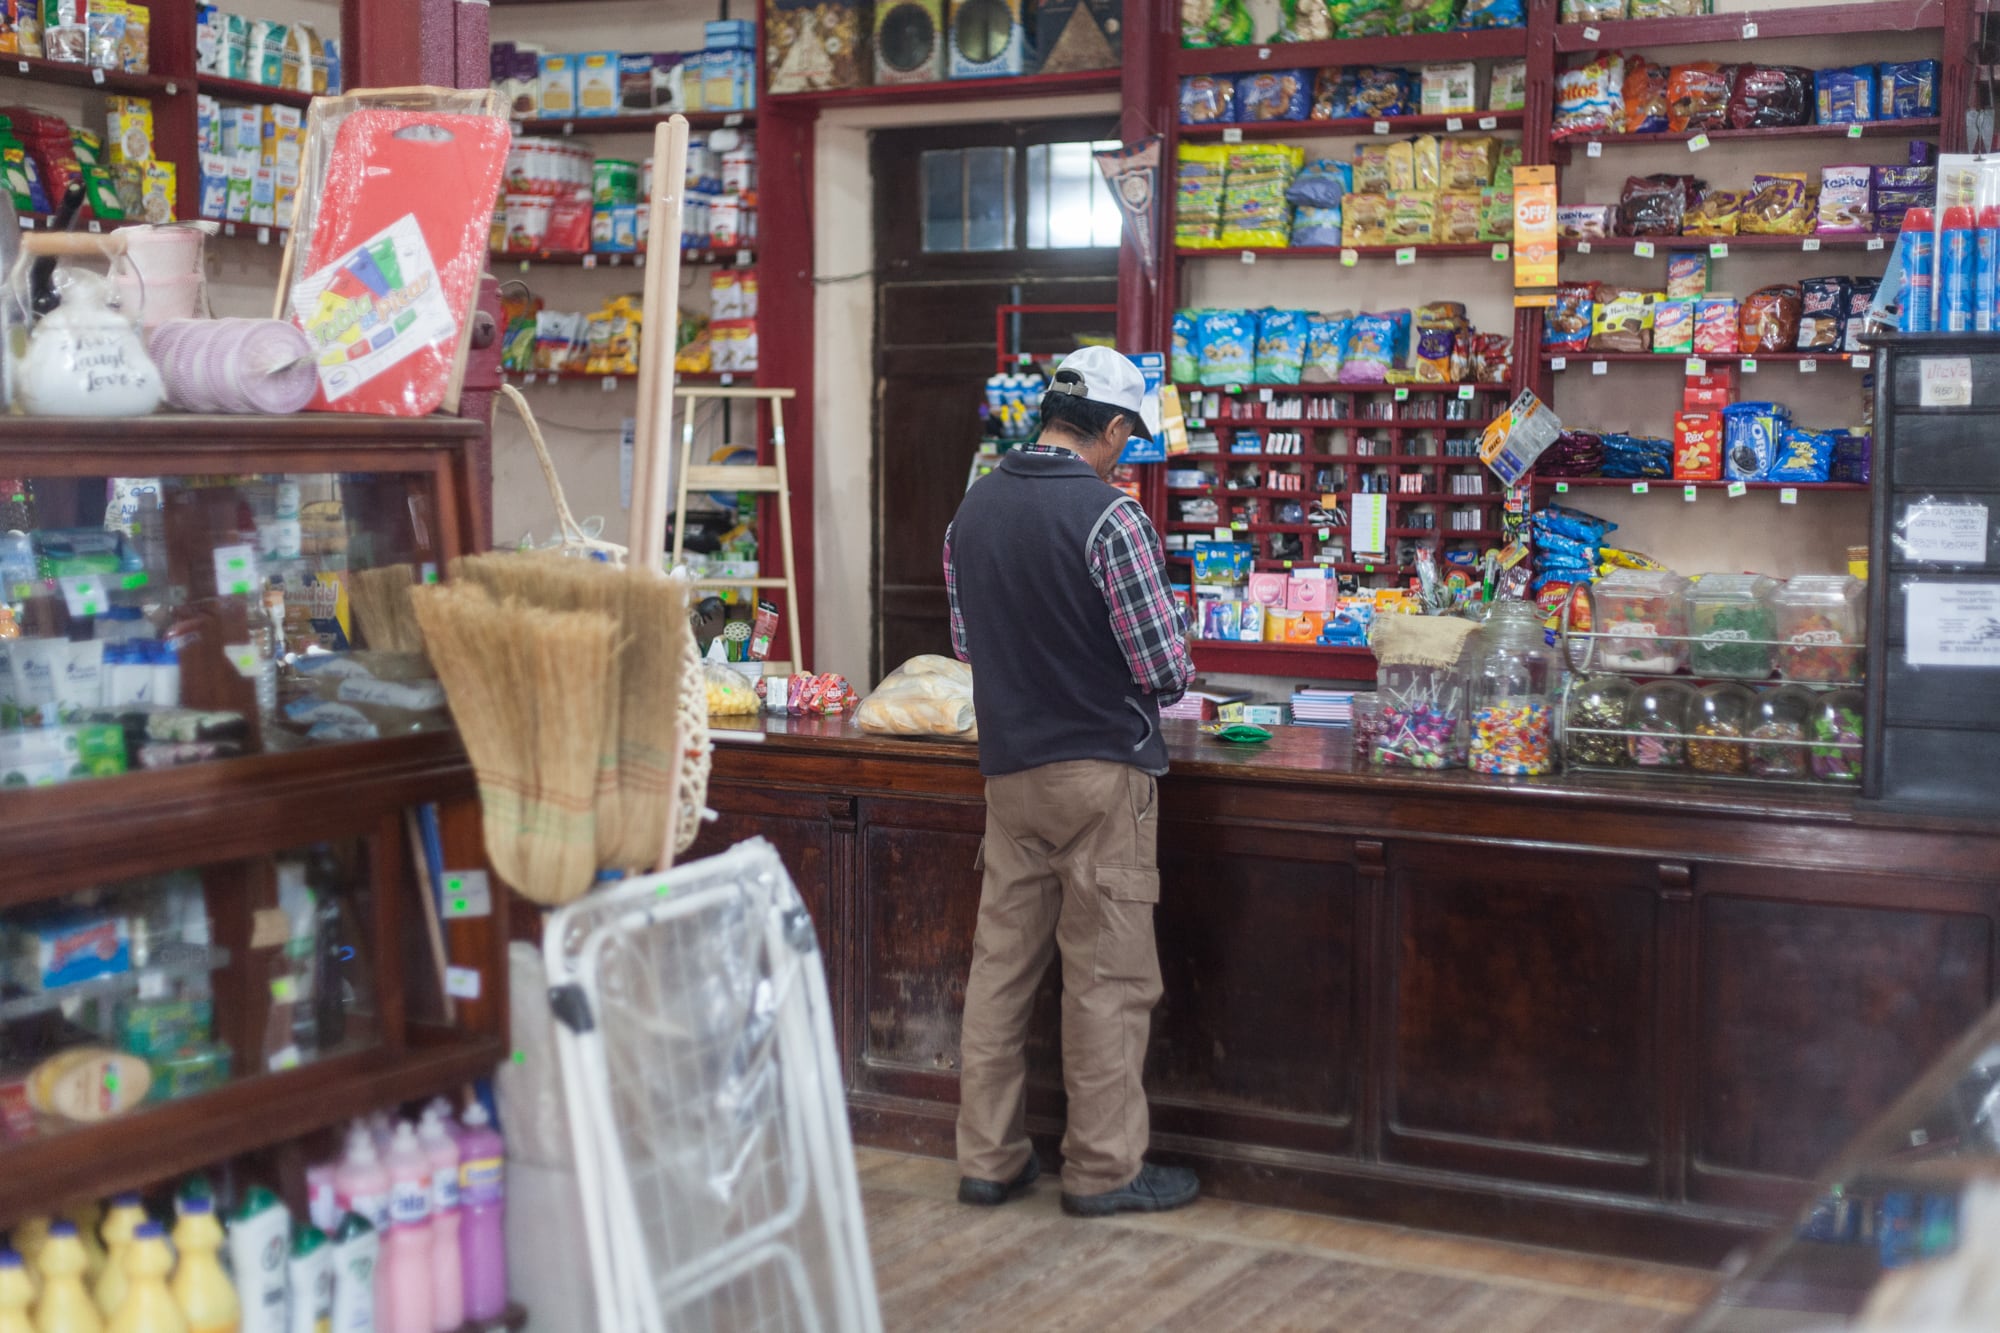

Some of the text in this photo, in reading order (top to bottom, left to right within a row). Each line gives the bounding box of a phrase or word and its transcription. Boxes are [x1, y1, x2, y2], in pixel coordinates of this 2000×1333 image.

[1517, 204, 1551, 221] OFF!
[1488, 436, 1503, 453] BIC
[1751, 423, 1767, 470] OREO
